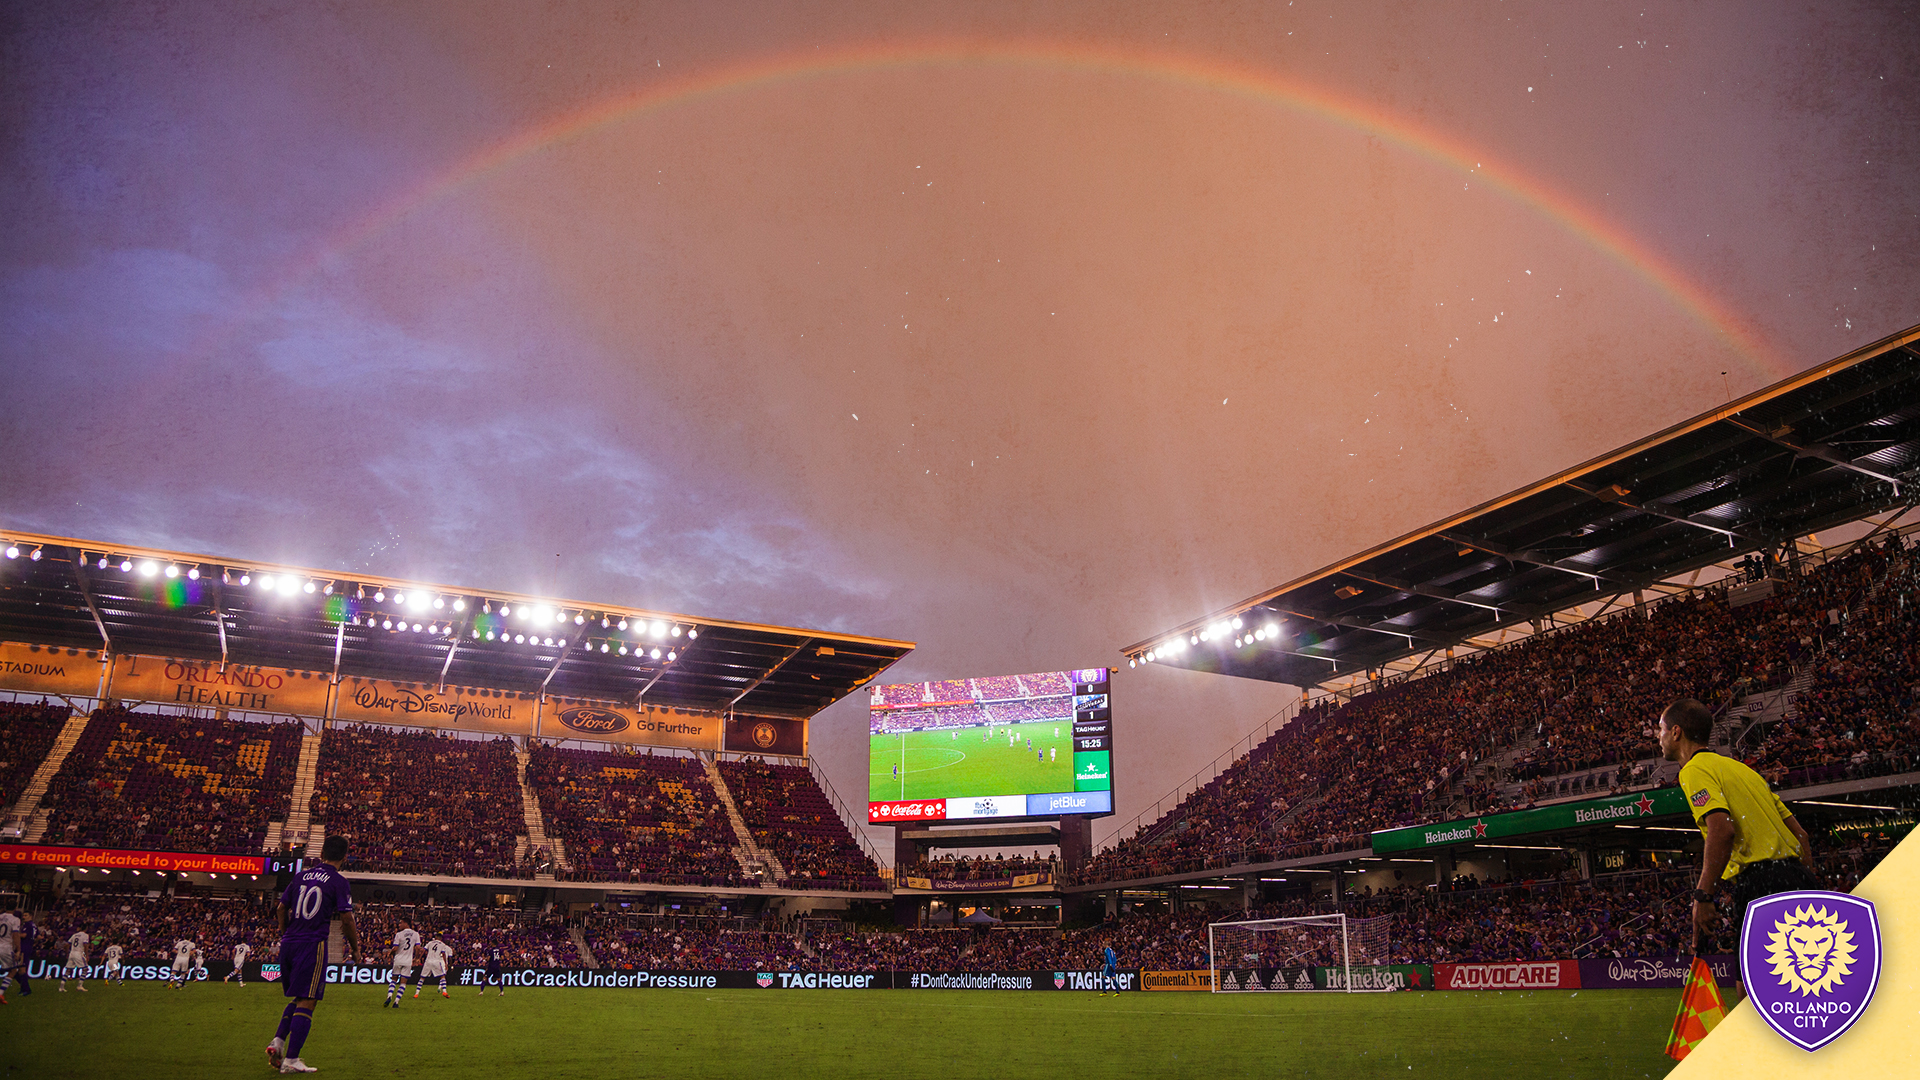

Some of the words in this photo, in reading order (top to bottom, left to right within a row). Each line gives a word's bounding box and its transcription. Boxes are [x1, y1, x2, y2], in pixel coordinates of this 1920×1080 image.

[164, 662, 284, 690] ORLANDO
[1087, 684, 1094, 693] 0
[175, 683, 268, 709] HEALTH
[467, 701, 513, 720] World
[1749, 702, 1763, 712] 104
[572, 710, 616, 731] Ford
[1089, 711, 1094, 720] 1
[637, 720, 655, 732] Go
[657, 721, 702, 735] Further
[1081, 739, 1102, 748] 15:25
[1050, 796, 1086, 810] jetBlue
[1575, 805, 1634, 823] Heineken
[1834, 820, 1872, 831] SOCCER
[1875, 818, 1885, 828] IS
[1888, 816, 1914, 826] HERE
[1425, 828, 1472, 844] Heineken
[16, 851, 26, 860] a
[32, 850, 71, 862] team
[76, 850, 150, 866] dedicated
[154, 856, 169, 867] to
[174, 859, 207, 871] your
[211, 857, 260, 871] health.
[1605, 855, 1625, 868] DEN
[295, 884, 323, 920] 10
[73, 937, 79, 948] 8
[182, 944, 188, 954] 6
[403, 937, 411, 951] 3
[432, 943, 438, 953] 4
[238, 947, 244, 955] 9
[911, 972, 1033, 990] #DontCrackUnderPressure
[1143, 973, 1190, 990] Continental
[1198, 975, 1218, 986] TIRE
[1325, 967, 1405, 989] Heneken
[1451, 965, 1558, 986] ADVOCARE
[1222, 982, 1240, 990] adidas
[1245, 982, 1262, 990] adida
[1270, 981, 1289, 990] adidas
[1294, 981, 1314, 990] adidas
